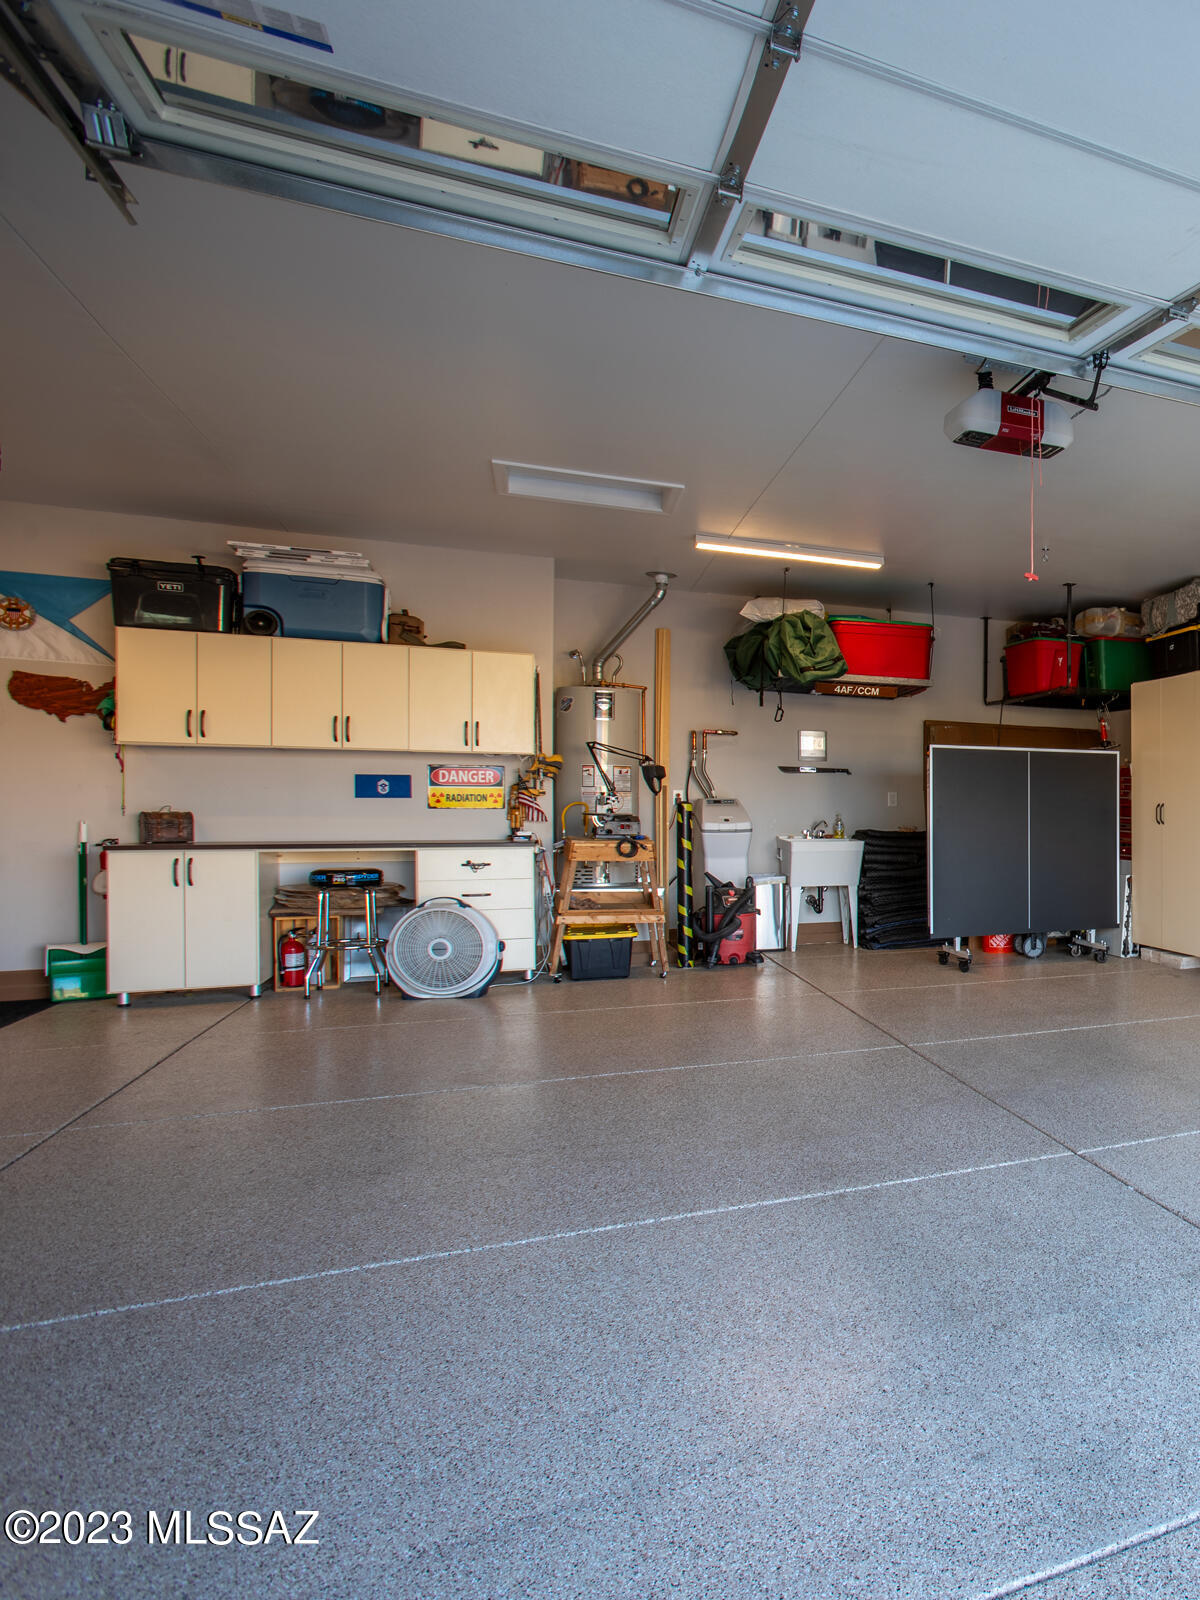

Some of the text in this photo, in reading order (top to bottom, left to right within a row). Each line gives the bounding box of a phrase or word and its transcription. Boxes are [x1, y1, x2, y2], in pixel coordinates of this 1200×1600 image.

[160, 583, 181, 591] YETI
[834, 685, 880, 696] 4AF/CCM
[438, 770, 495, 784] DANGER
[445, 793, 488, 803] RADIATION
